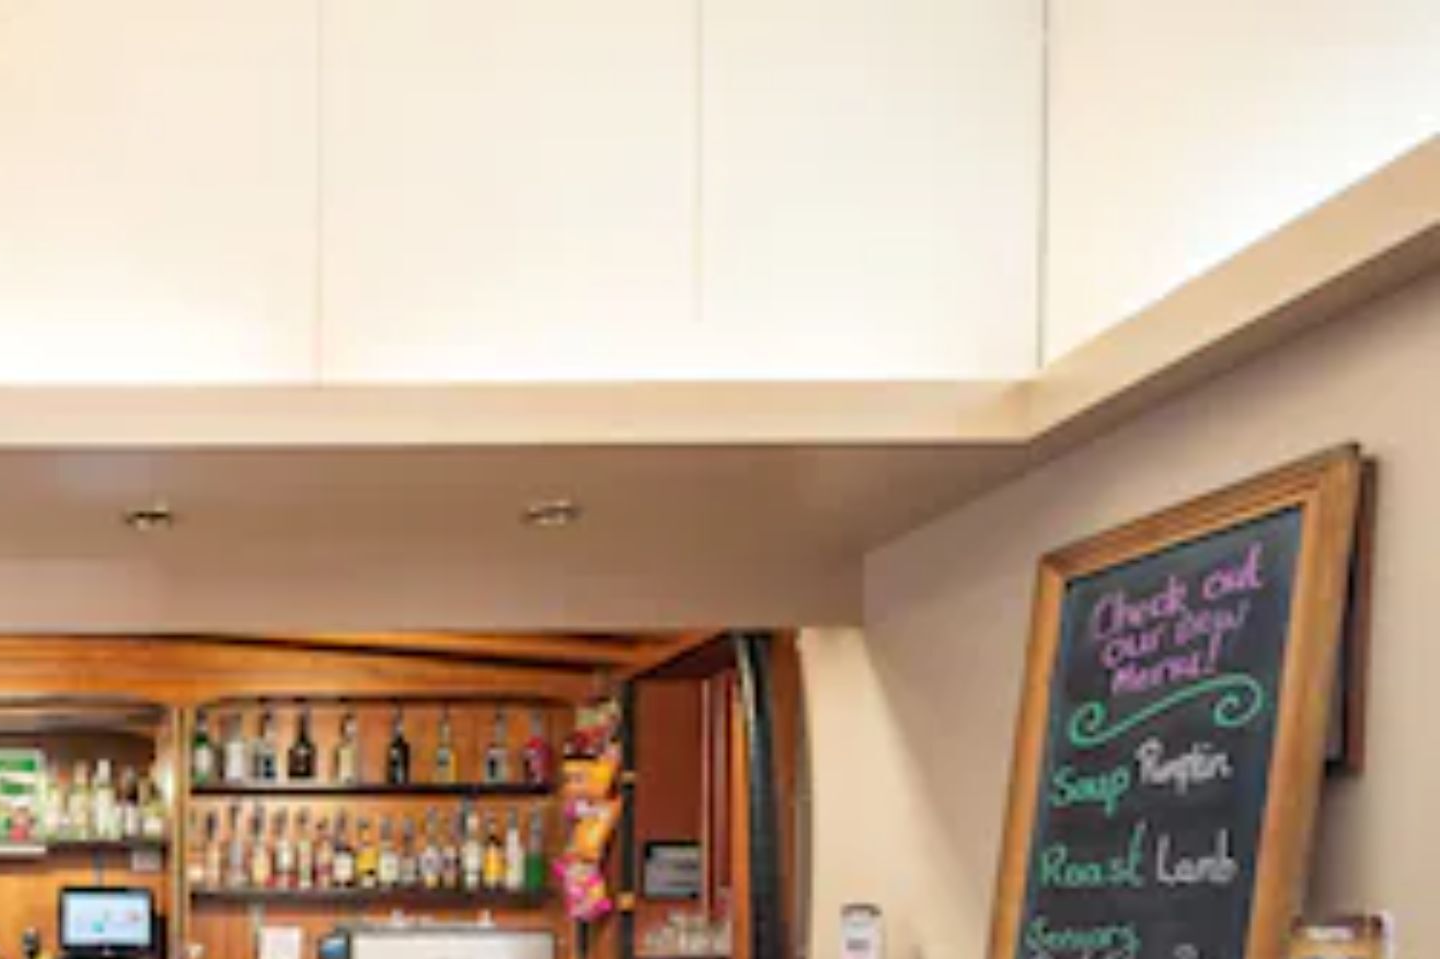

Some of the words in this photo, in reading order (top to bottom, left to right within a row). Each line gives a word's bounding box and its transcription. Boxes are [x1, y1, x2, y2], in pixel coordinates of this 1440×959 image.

[1092, 574, 1188, 642] Check
[1050, 764, 1132, 818] Soup
[1039, 818, 1148, 888] Roast
[1156, 828, 1238, 886] Lamb
